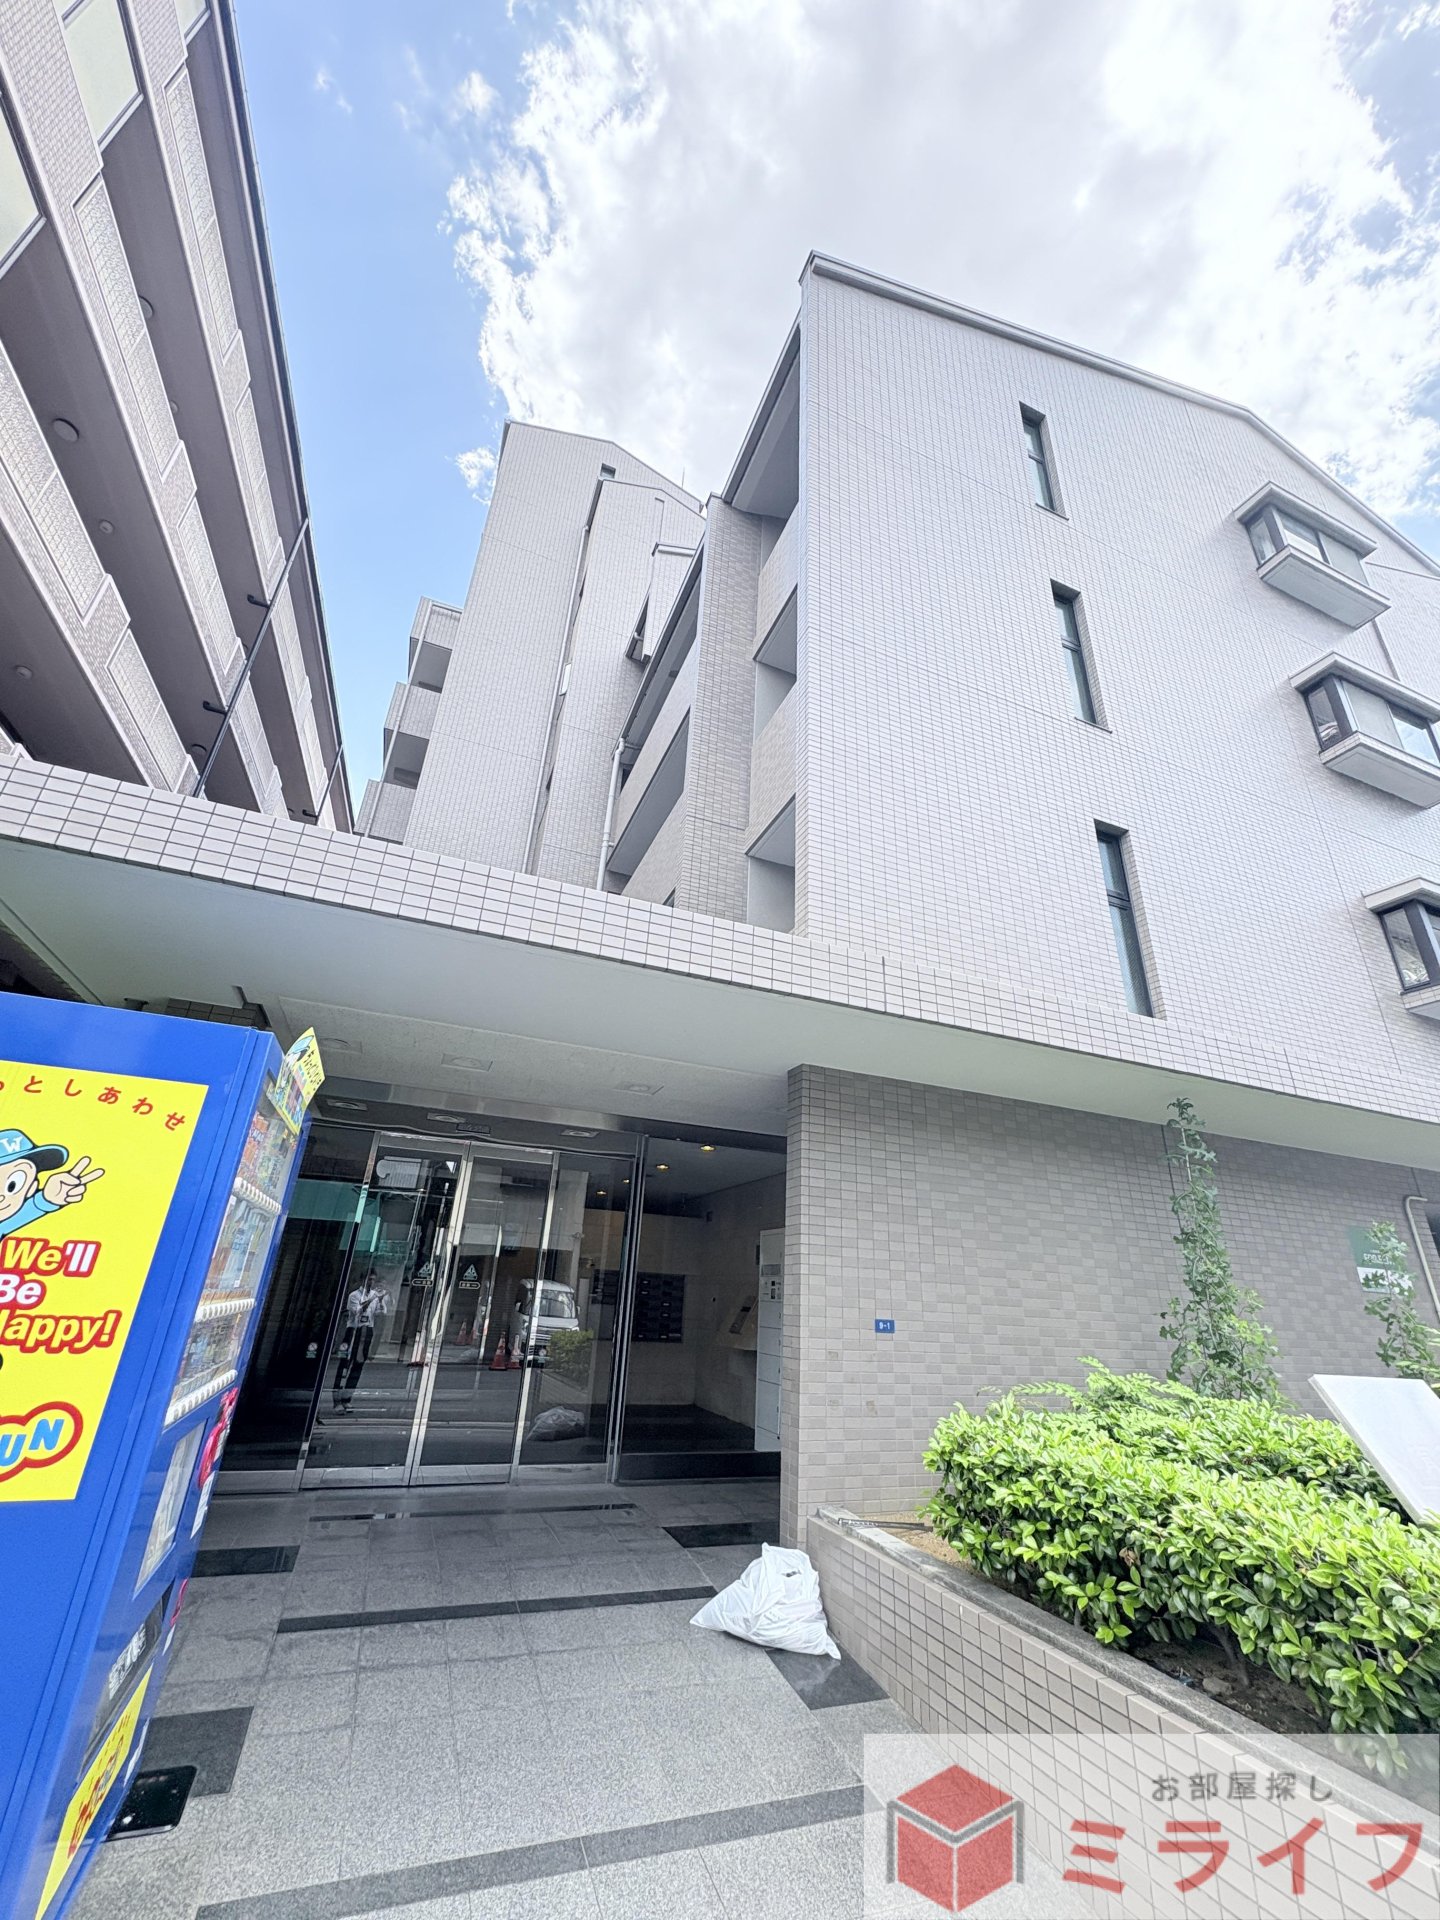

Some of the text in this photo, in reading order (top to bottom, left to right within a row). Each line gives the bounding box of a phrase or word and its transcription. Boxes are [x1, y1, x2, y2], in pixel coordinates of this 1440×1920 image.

[1, 1137, 23, 1152] W
[3, 1239, 97, 1273] We'll
[0, 1273, 42, 1305] Be
